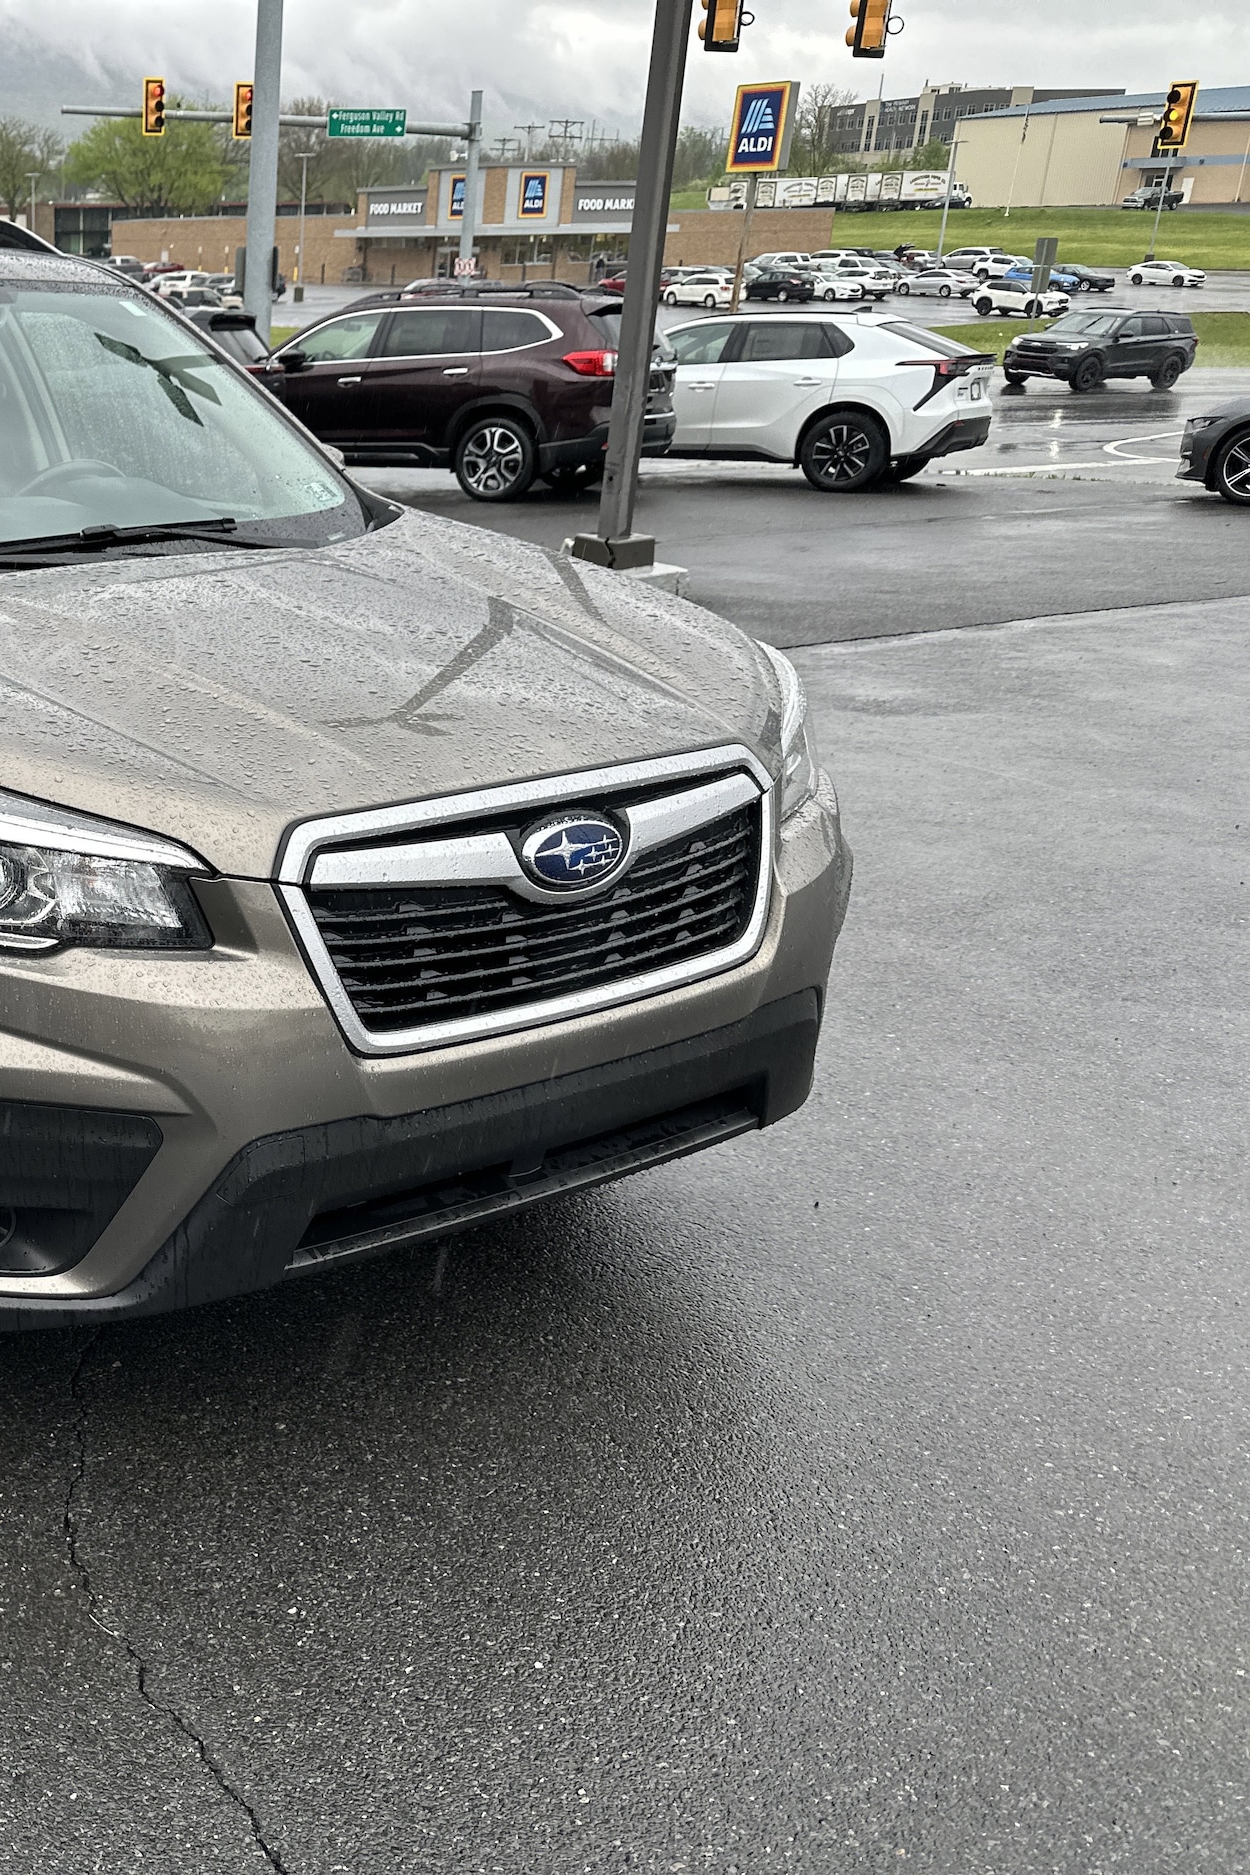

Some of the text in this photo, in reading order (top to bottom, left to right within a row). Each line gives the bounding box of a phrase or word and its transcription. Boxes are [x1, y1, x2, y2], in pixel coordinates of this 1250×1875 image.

[339, 111, 405, 123] Ferguson Valley Rd
[340, 123, 385, 134] Freedom Ave
[738, 136, 773, 153] ALDI
[370, 202, 423, 215] FOOD MARKET
[523, 199, 543, 209] ALDI
[578, 199, 603, 210] FOOD
